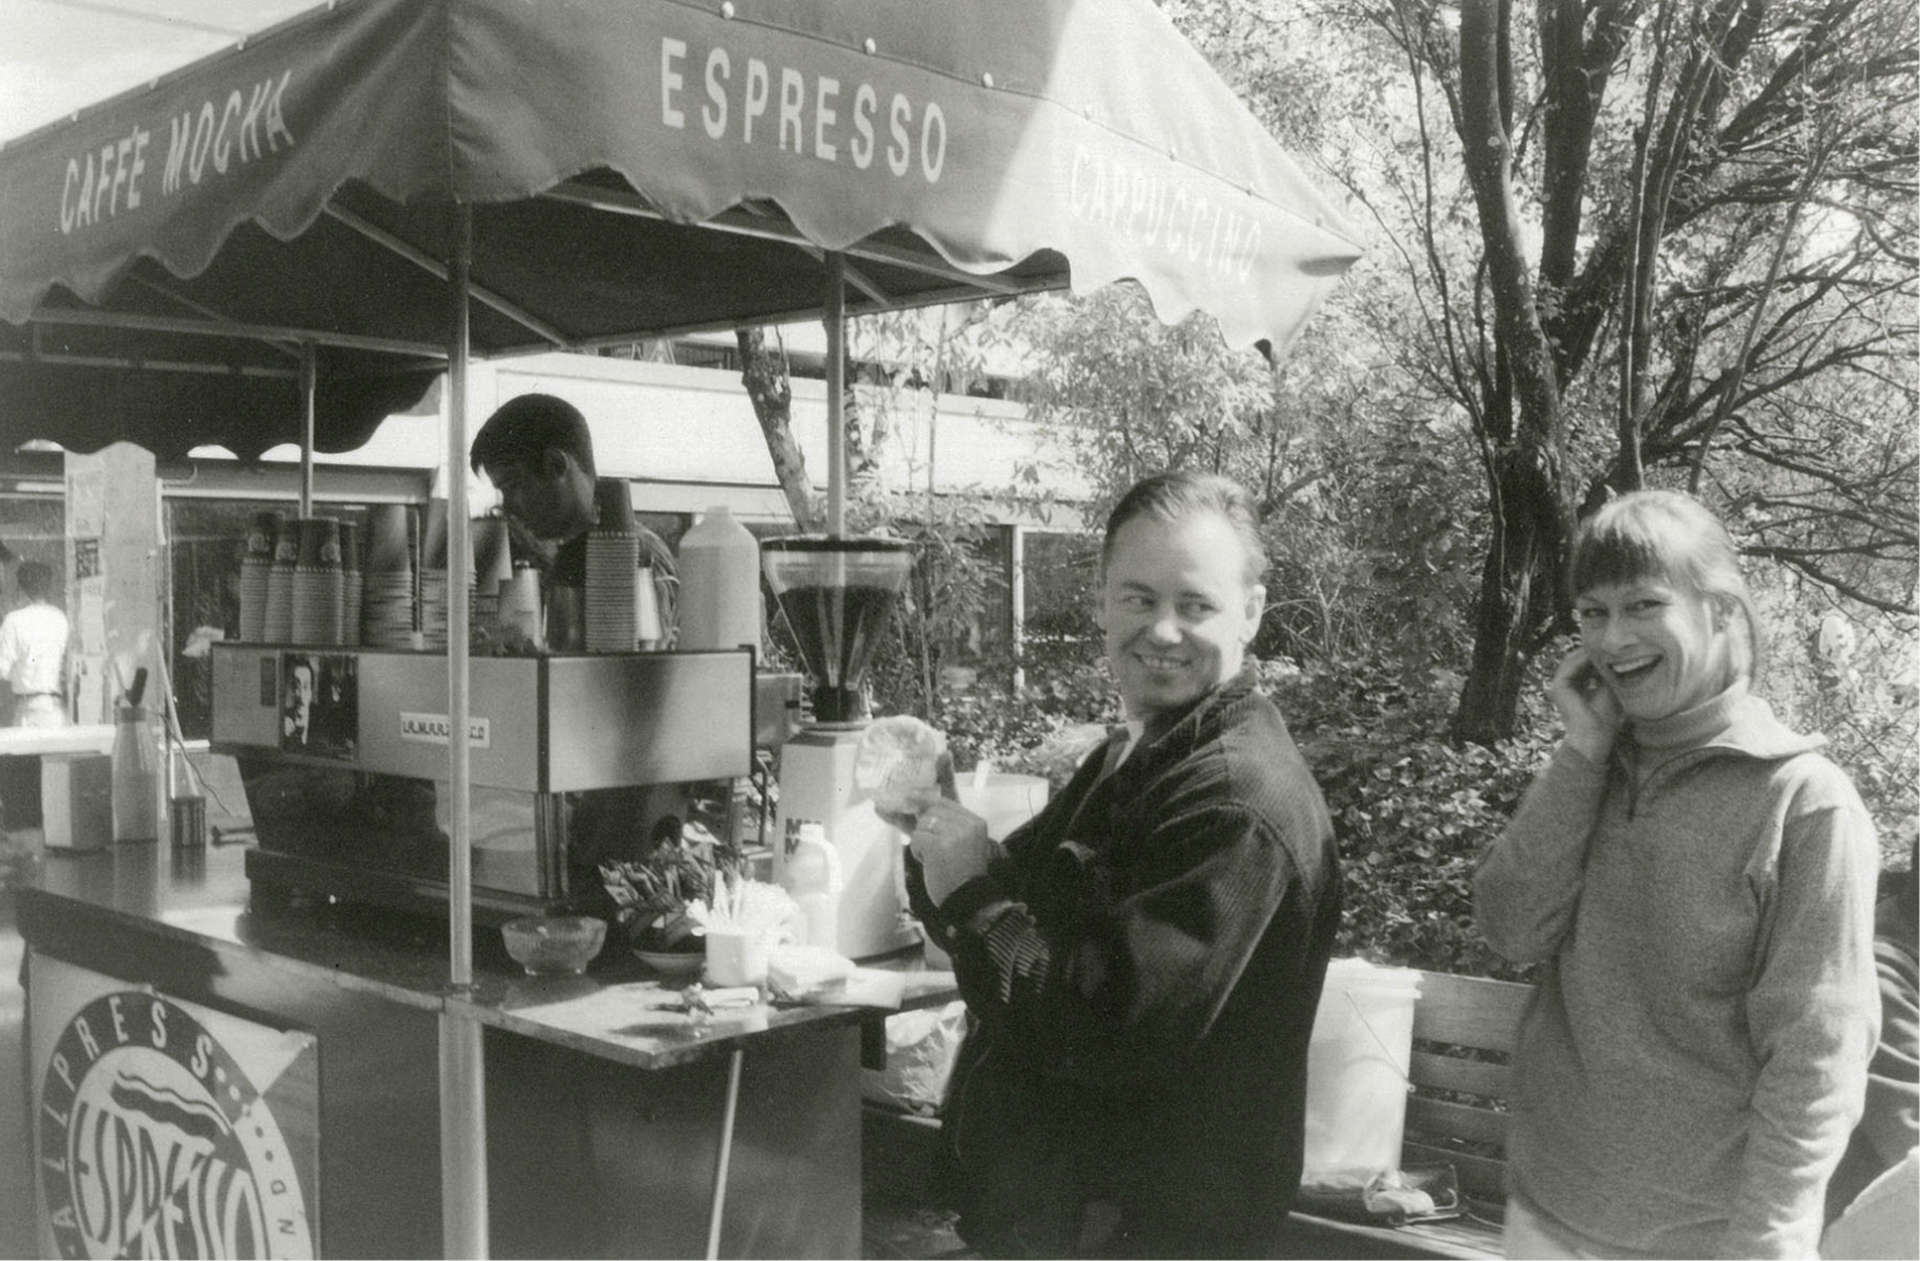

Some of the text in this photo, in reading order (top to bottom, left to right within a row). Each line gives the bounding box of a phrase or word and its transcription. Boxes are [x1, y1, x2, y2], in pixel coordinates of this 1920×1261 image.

[163, 69, 294, 196] MOCHA
[660, 37, 947, 183] ESPRESSO
[1071, 145, 1261, 283] CAPPUCCINO
